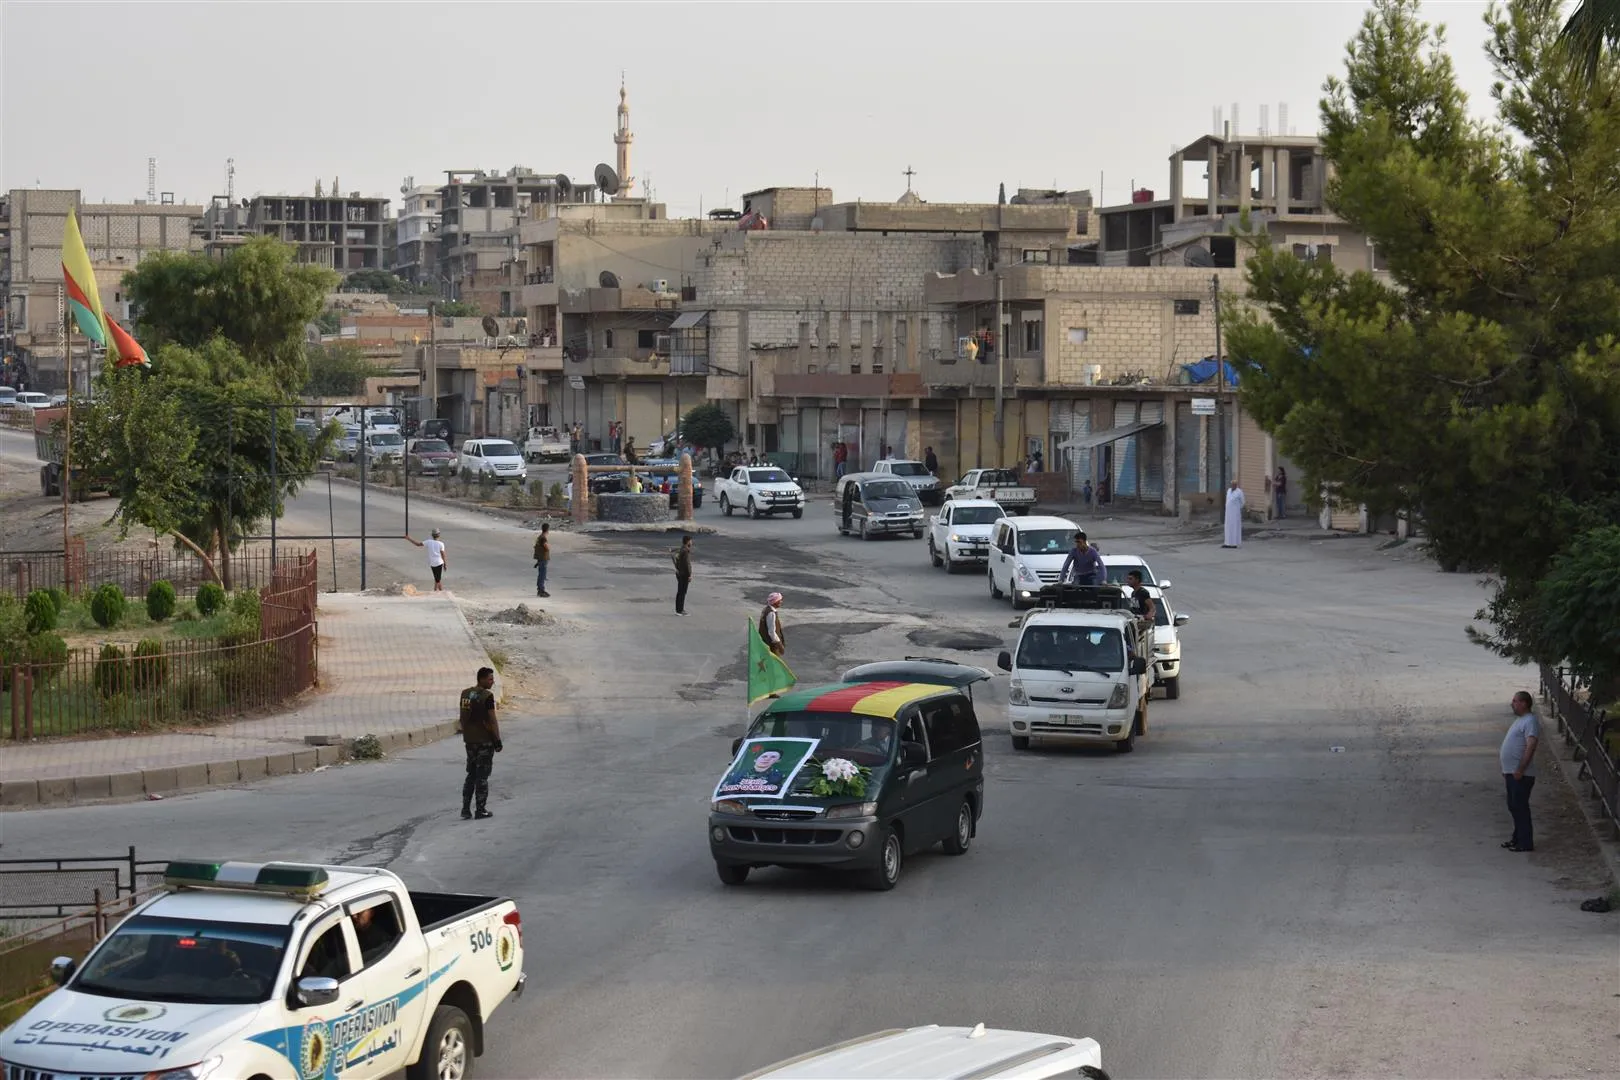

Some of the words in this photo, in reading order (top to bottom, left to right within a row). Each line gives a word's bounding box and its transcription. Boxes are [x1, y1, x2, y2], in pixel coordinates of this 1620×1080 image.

[470, 927, 492, 953] 506
[28, 1020, 188, 1043] OPERASIYON
[332, 998, 399, 1050] OPERASIYON
[13, 1033, 171, 1059] العمليات
